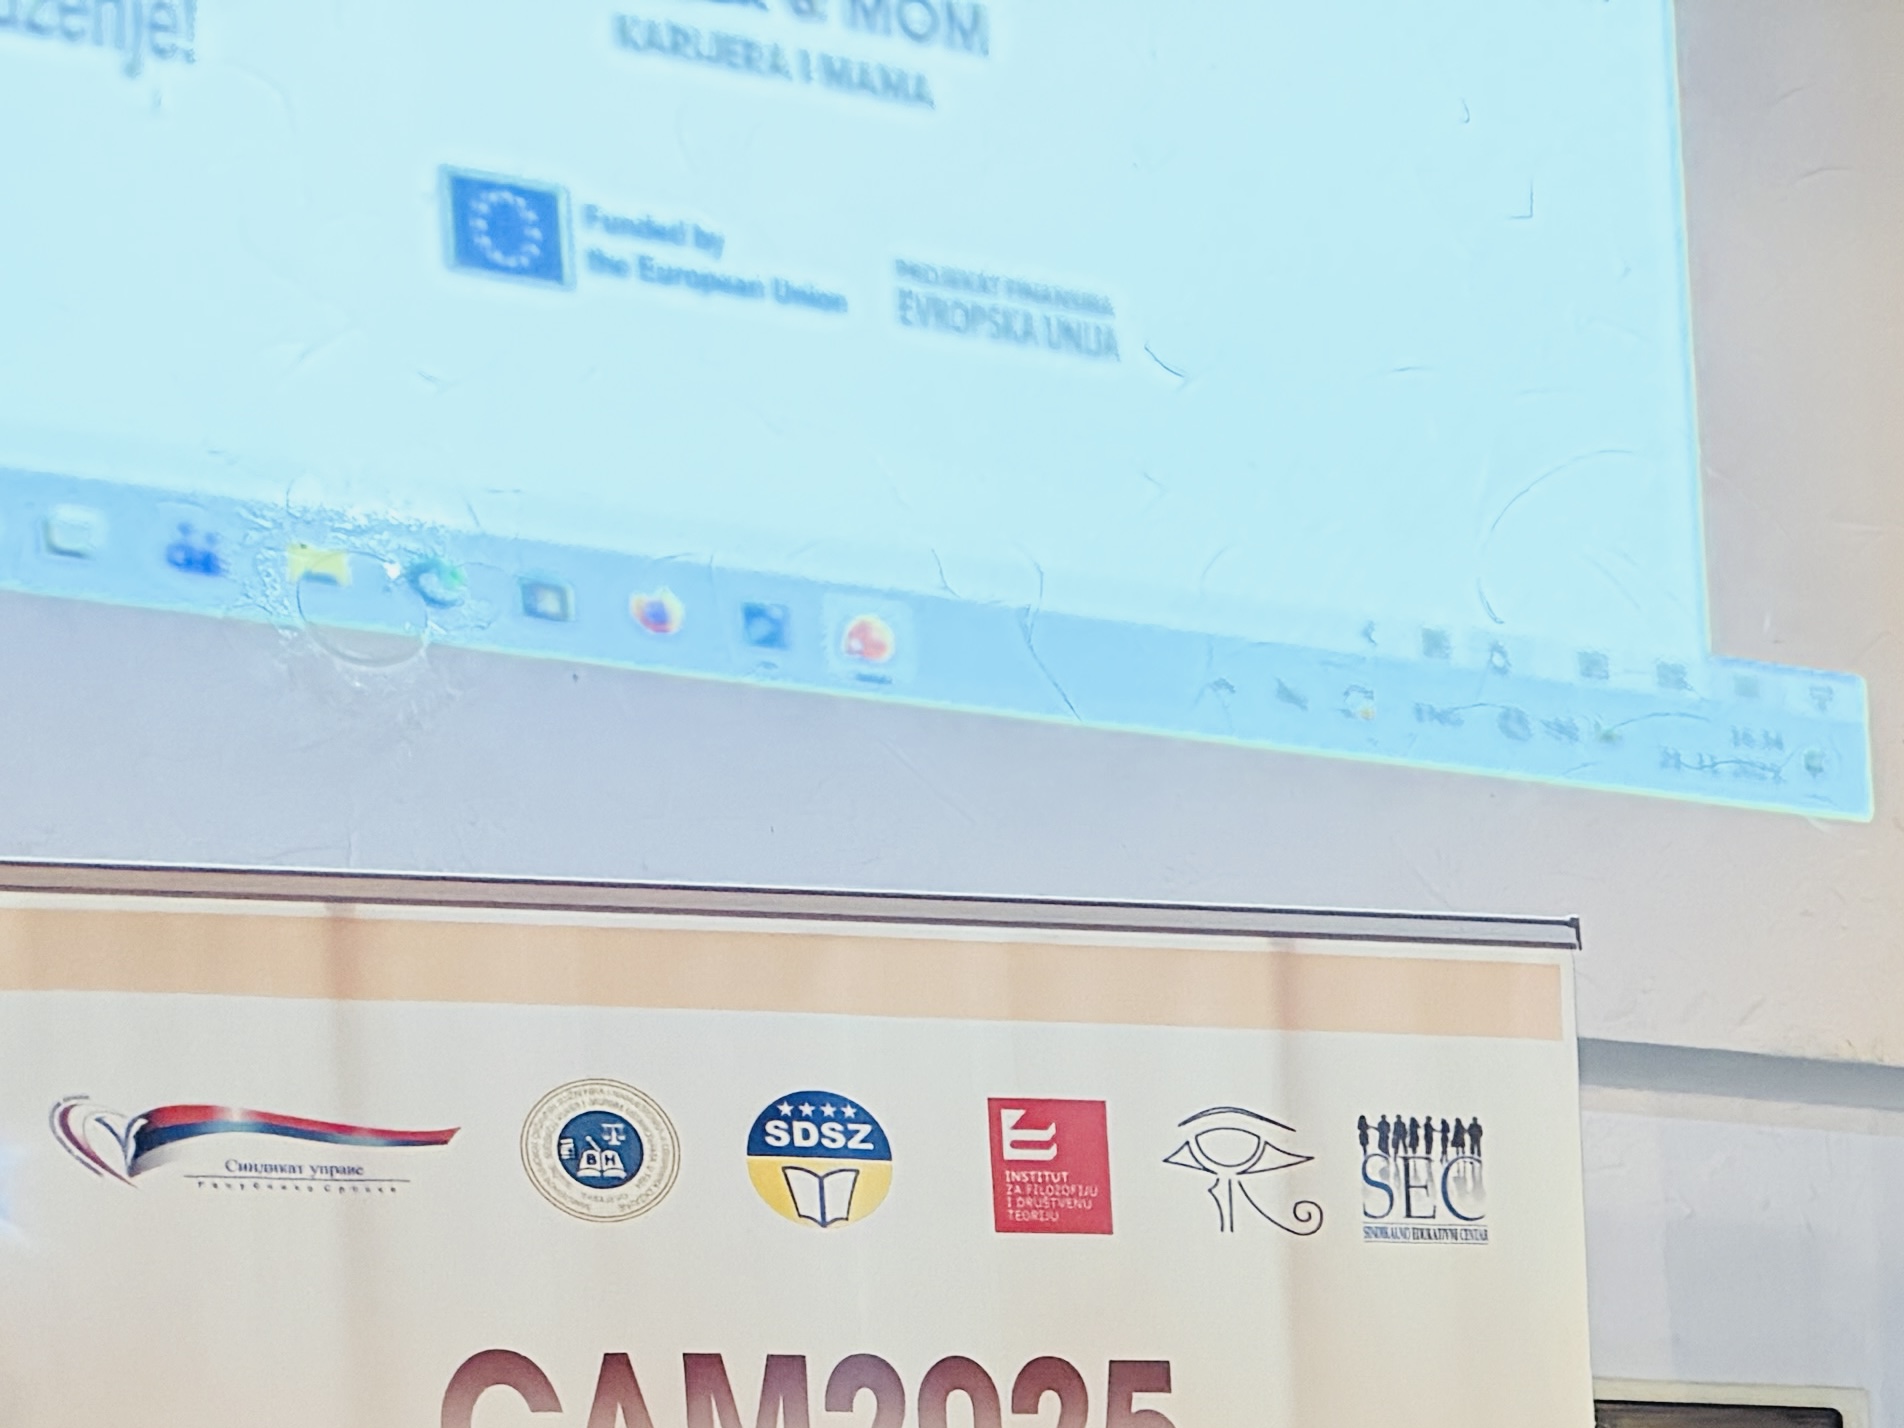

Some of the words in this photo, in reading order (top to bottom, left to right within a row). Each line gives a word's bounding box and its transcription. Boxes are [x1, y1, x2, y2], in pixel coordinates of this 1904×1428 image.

[764, 1119, 875, 1152] SDSZ
[1005, 1170, 1069, 1183] INSTITUT
[1361, 1153, 1487, 1222] SEC
